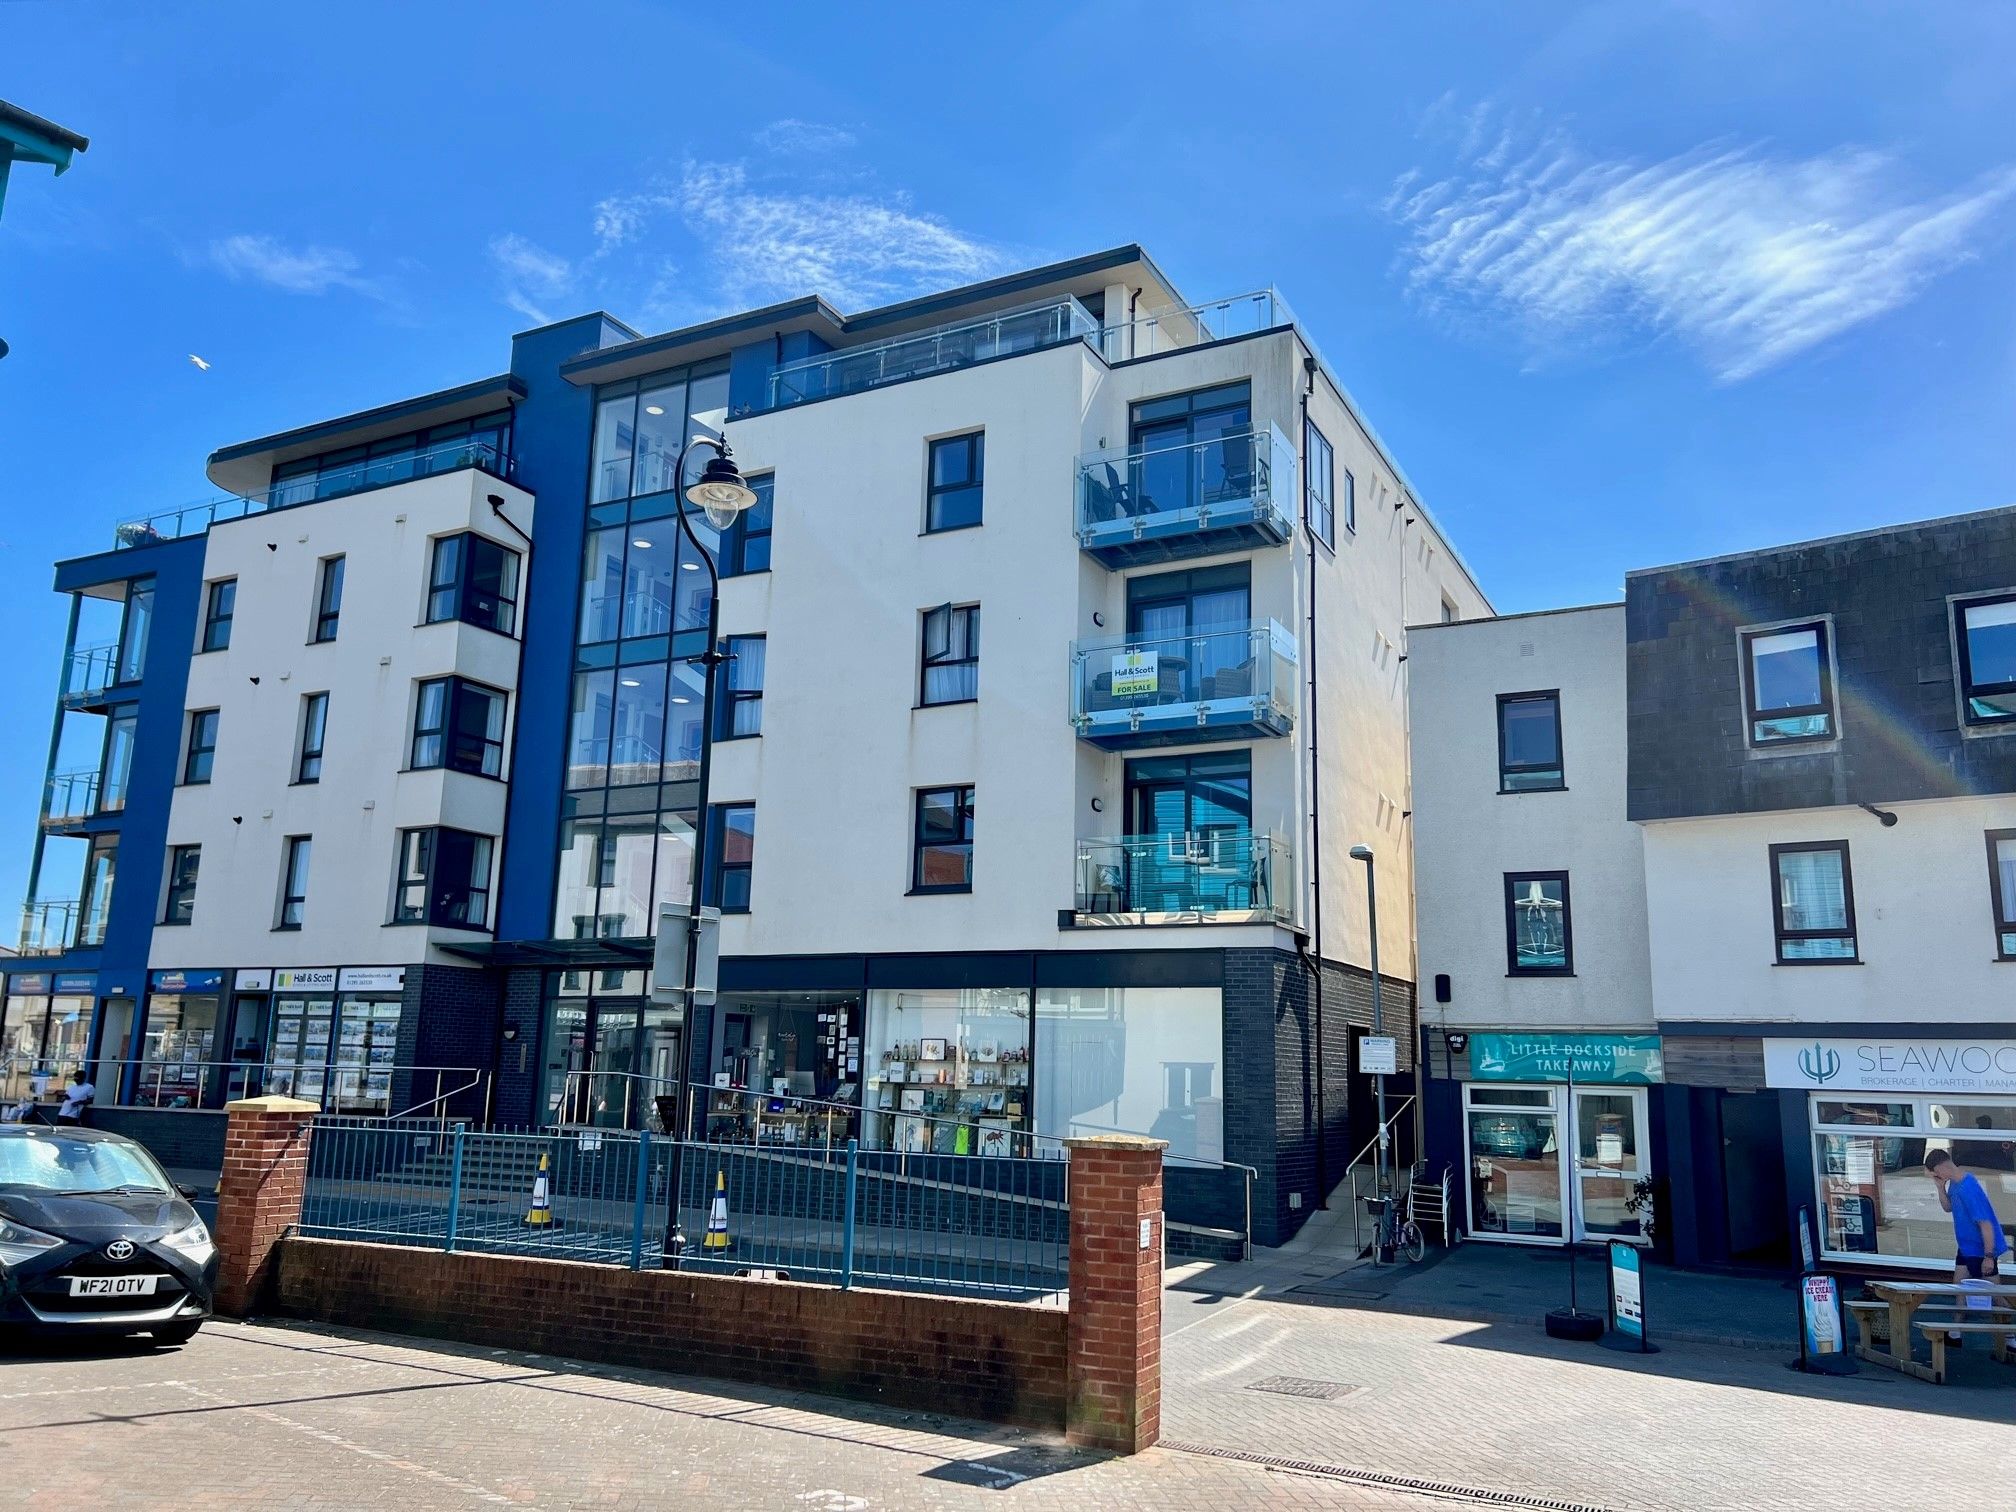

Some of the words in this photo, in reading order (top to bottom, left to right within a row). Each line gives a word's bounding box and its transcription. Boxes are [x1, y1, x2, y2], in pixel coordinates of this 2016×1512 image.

[1135, 666, 1154, 674] Scott
[1132, 684, 1151, 692] SALE
[294, 973, 306, 982] Hall
[307, 973, 312, 982] &
[313, 973, 332, 982] Scott
[1511, 1044, 1559, 1056] LITTLE
[1564, 1044, 1637, 1057] DOCKSIDE
[1536, 1059, 1611, 1072] TAKEAWAY
[1860, 1076, 1918, 1086] BROKERAGE
[1928, 1078, 1975, 1087] CHARTER
[1985, 1079, 2016, 1088] MANA
[80, 1280, 113, 1293] WF21
[116, 1279, 145, 1292] OTV
[1815, 1286, 1834, 1294] CREAM
[1813, 1294, 1828, 1302] HERE
